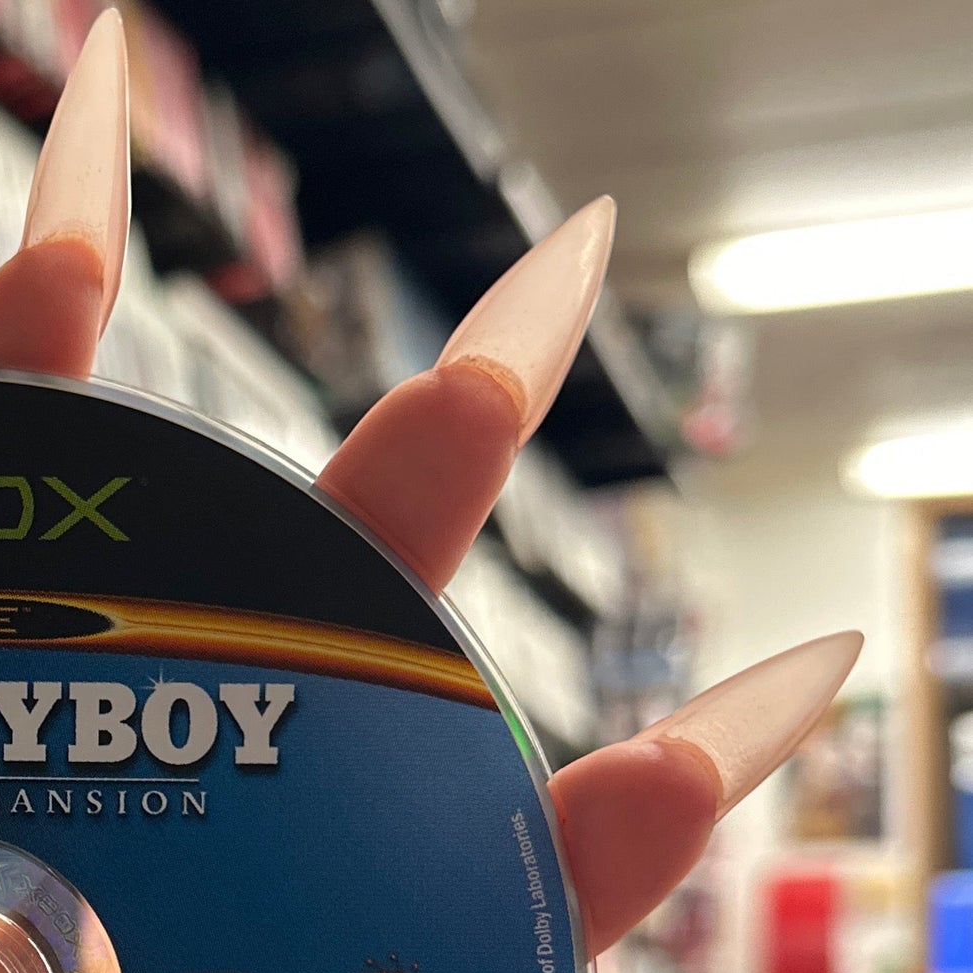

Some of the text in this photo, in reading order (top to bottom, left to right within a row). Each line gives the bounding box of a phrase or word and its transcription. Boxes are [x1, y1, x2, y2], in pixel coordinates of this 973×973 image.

[511, 808, 546, 909] Laboratories.
[533, 910, 553, 955] Dolby
[537, 958, 554, 973] of
